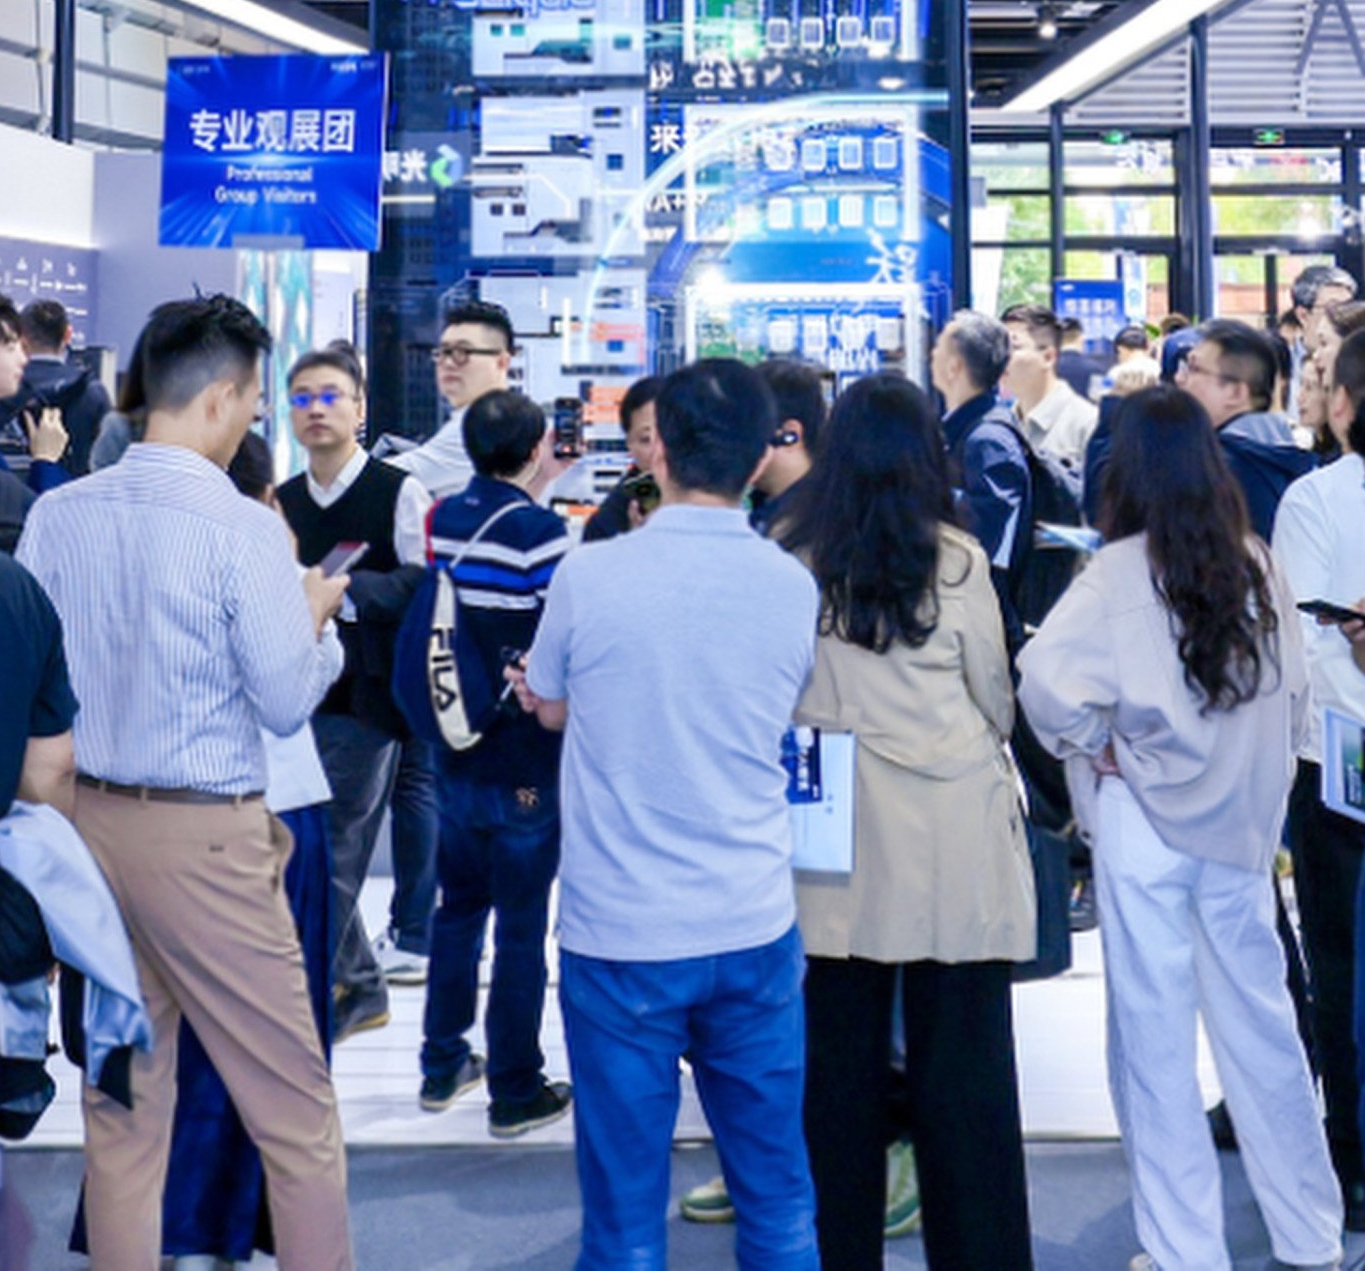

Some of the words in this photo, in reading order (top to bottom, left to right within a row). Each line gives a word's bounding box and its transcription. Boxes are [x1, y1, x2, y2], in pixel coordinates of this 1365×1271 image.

[189, 108, 356, 152] 专业观展团
[226, 164, 313, 182] Professional
[214, 186, 258, 205] Group
[263, 185, 317, 204] Visitors
[431, 627, 458, 712] FILA
